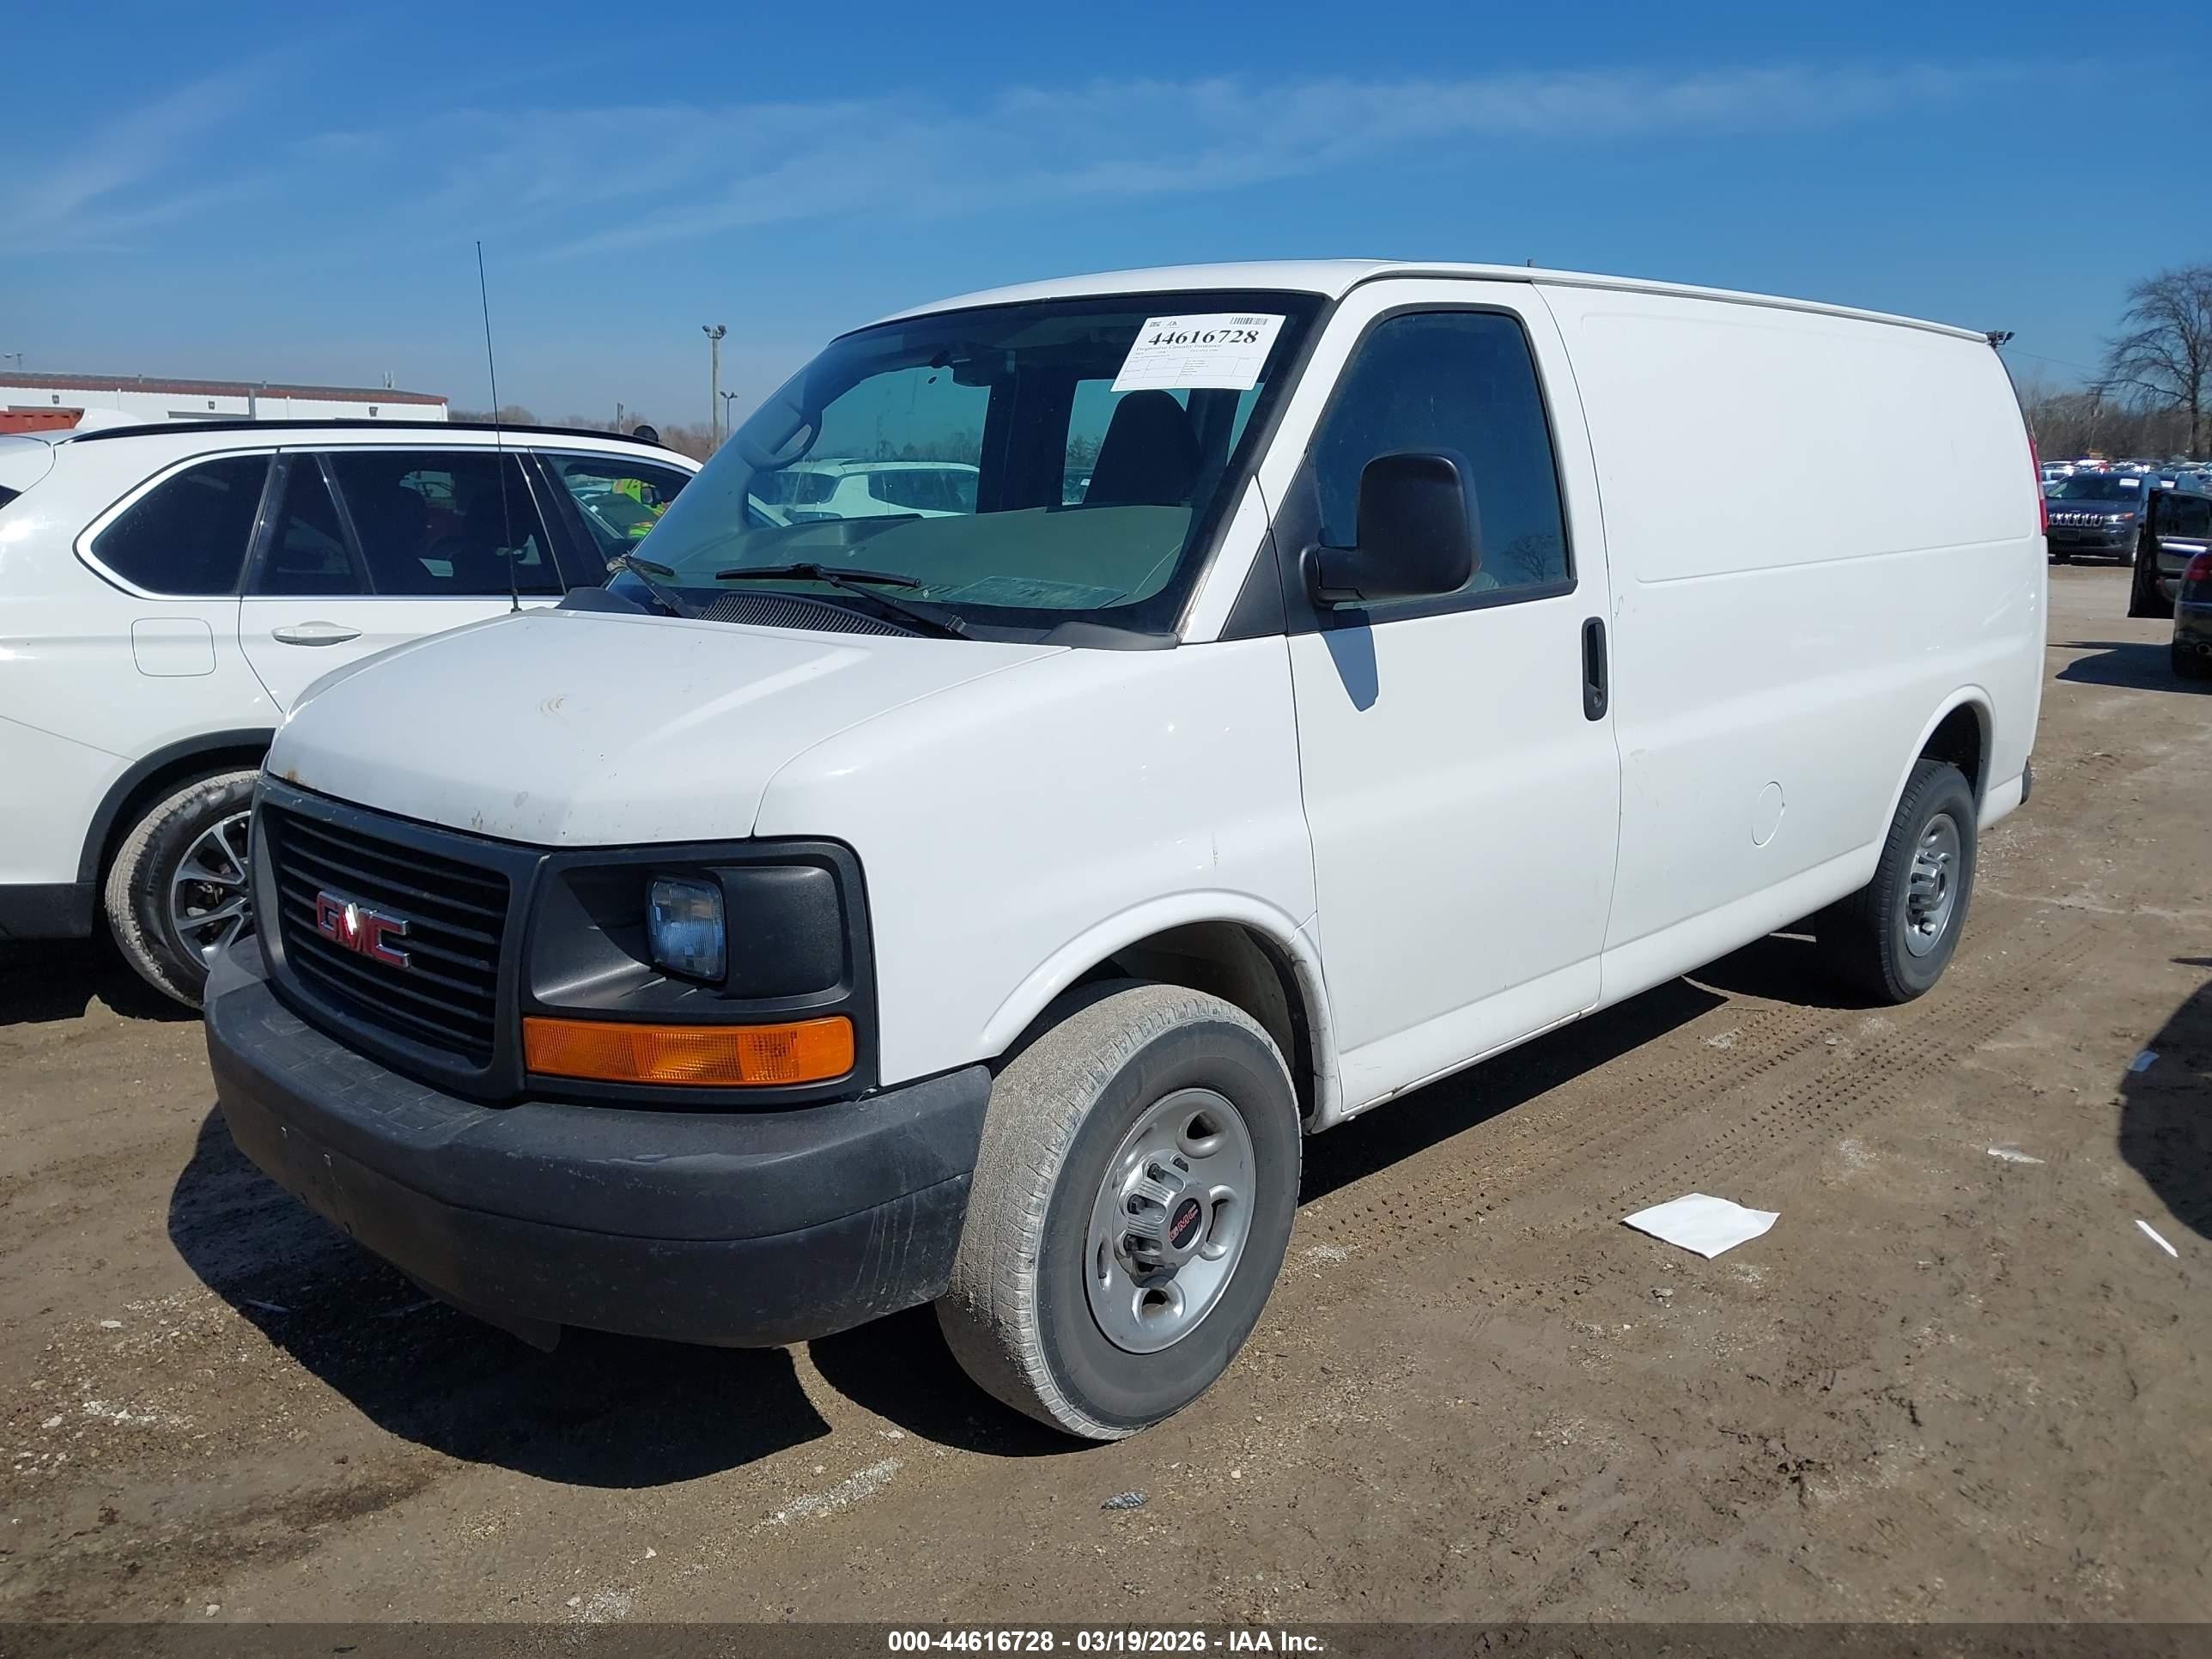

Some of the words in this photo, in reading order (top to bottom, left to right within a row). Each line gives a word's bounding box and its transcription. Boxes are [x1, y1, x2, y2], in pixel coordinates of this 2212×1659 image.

[1148, 329, 1260, 345] 44616728
[316, 890, 410, 969] GMC
[1169, 1203, 1199, 1243] GMC
